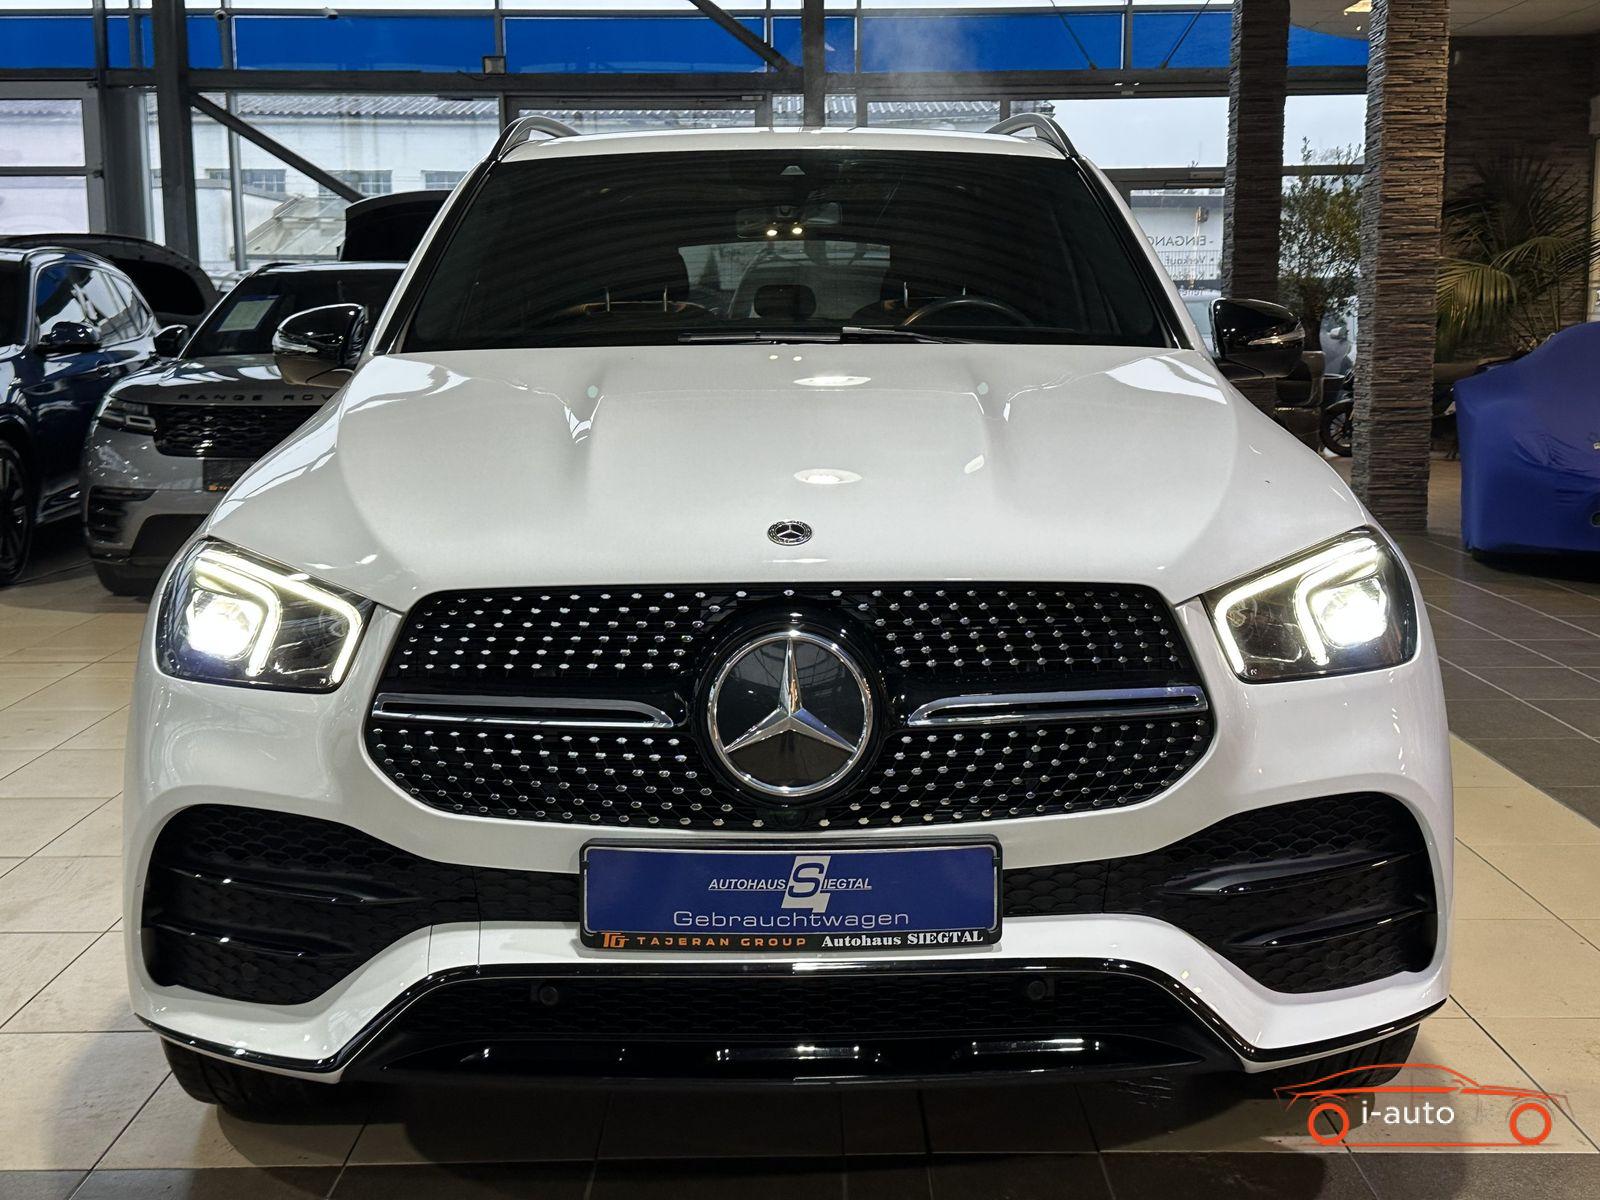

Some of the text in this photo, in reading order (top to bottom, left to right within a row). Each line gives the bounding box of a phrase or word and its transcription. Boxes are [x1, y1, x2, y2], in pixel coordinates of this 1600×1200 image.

[177, 393, 333, 401] RANGE ROV
[708, 878, 787, 890] AUTOHAUS
[673, 910, 909, 929] Gebrauchtwagen
[637, 936, 729, 946] TAJERAN
[740, 937, 806, 946] GROUP
[822, 935, 901, 948] Autohaus
[907, 930, 984, 945] SIEGTAL
